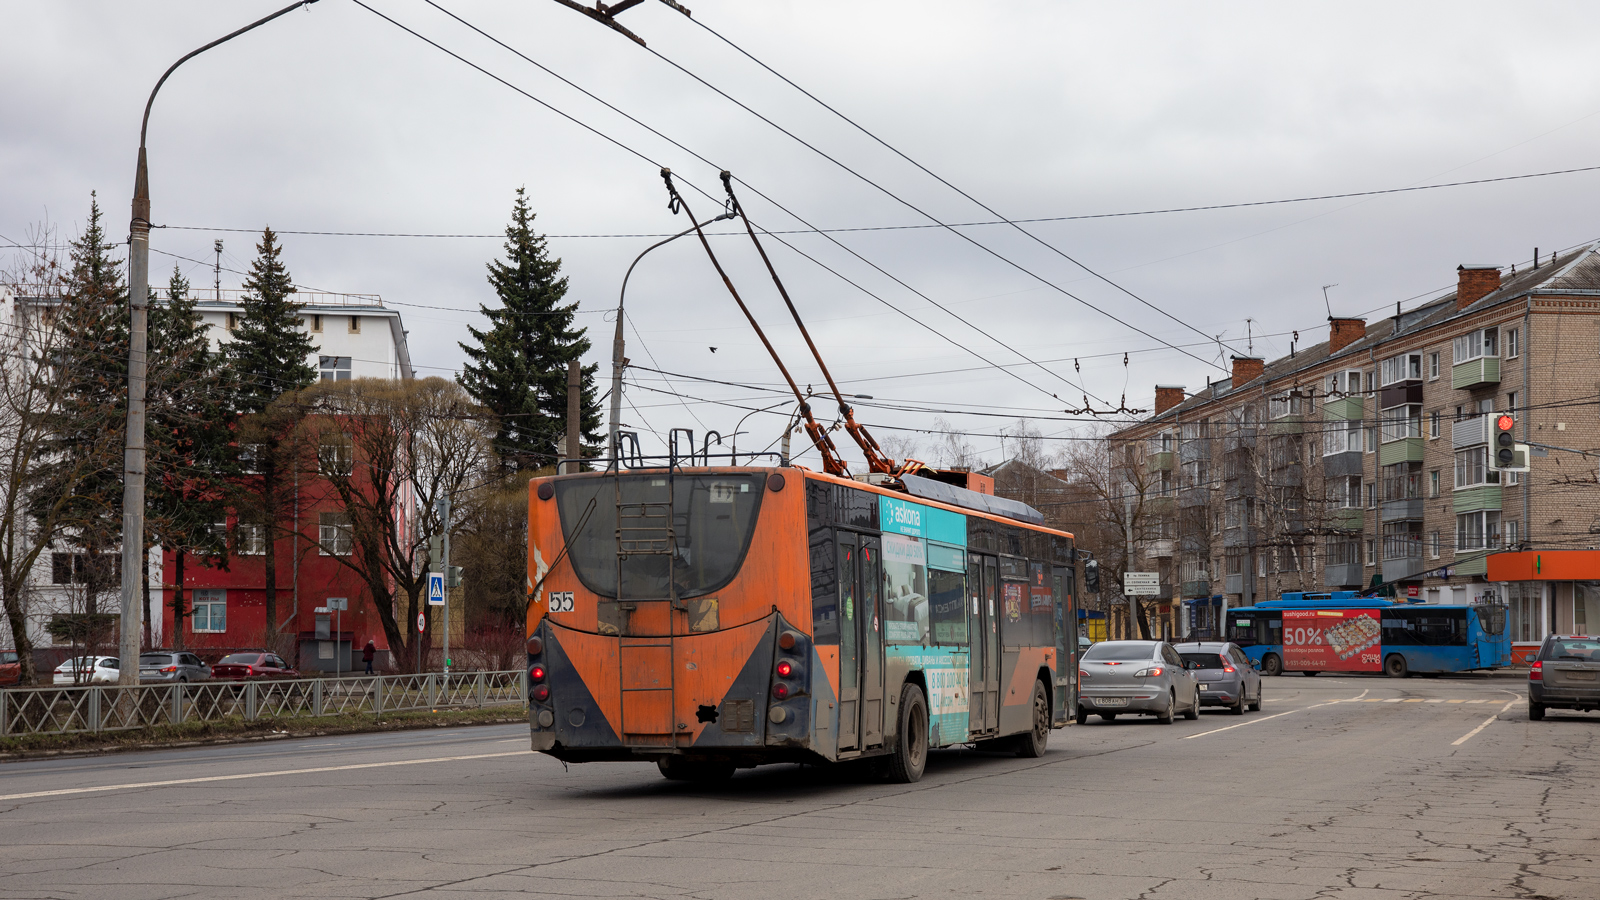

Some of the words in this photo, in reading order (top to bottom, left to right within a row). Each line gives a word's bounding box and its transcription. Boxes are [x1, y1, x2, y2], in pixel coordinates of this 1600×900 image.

[895, 501, 920, 527] askona
[886, 540, 906, 559] СКИДКИ
[905, 543, 913, 559] ДО
[550, 592, 574, 611] 55
[419, 618, 424, 627] 40
[1284, 627, 1322, 646] 50%
[932, 672, 935, 689] 8
[932, 693, 940, 711] ТЦ
